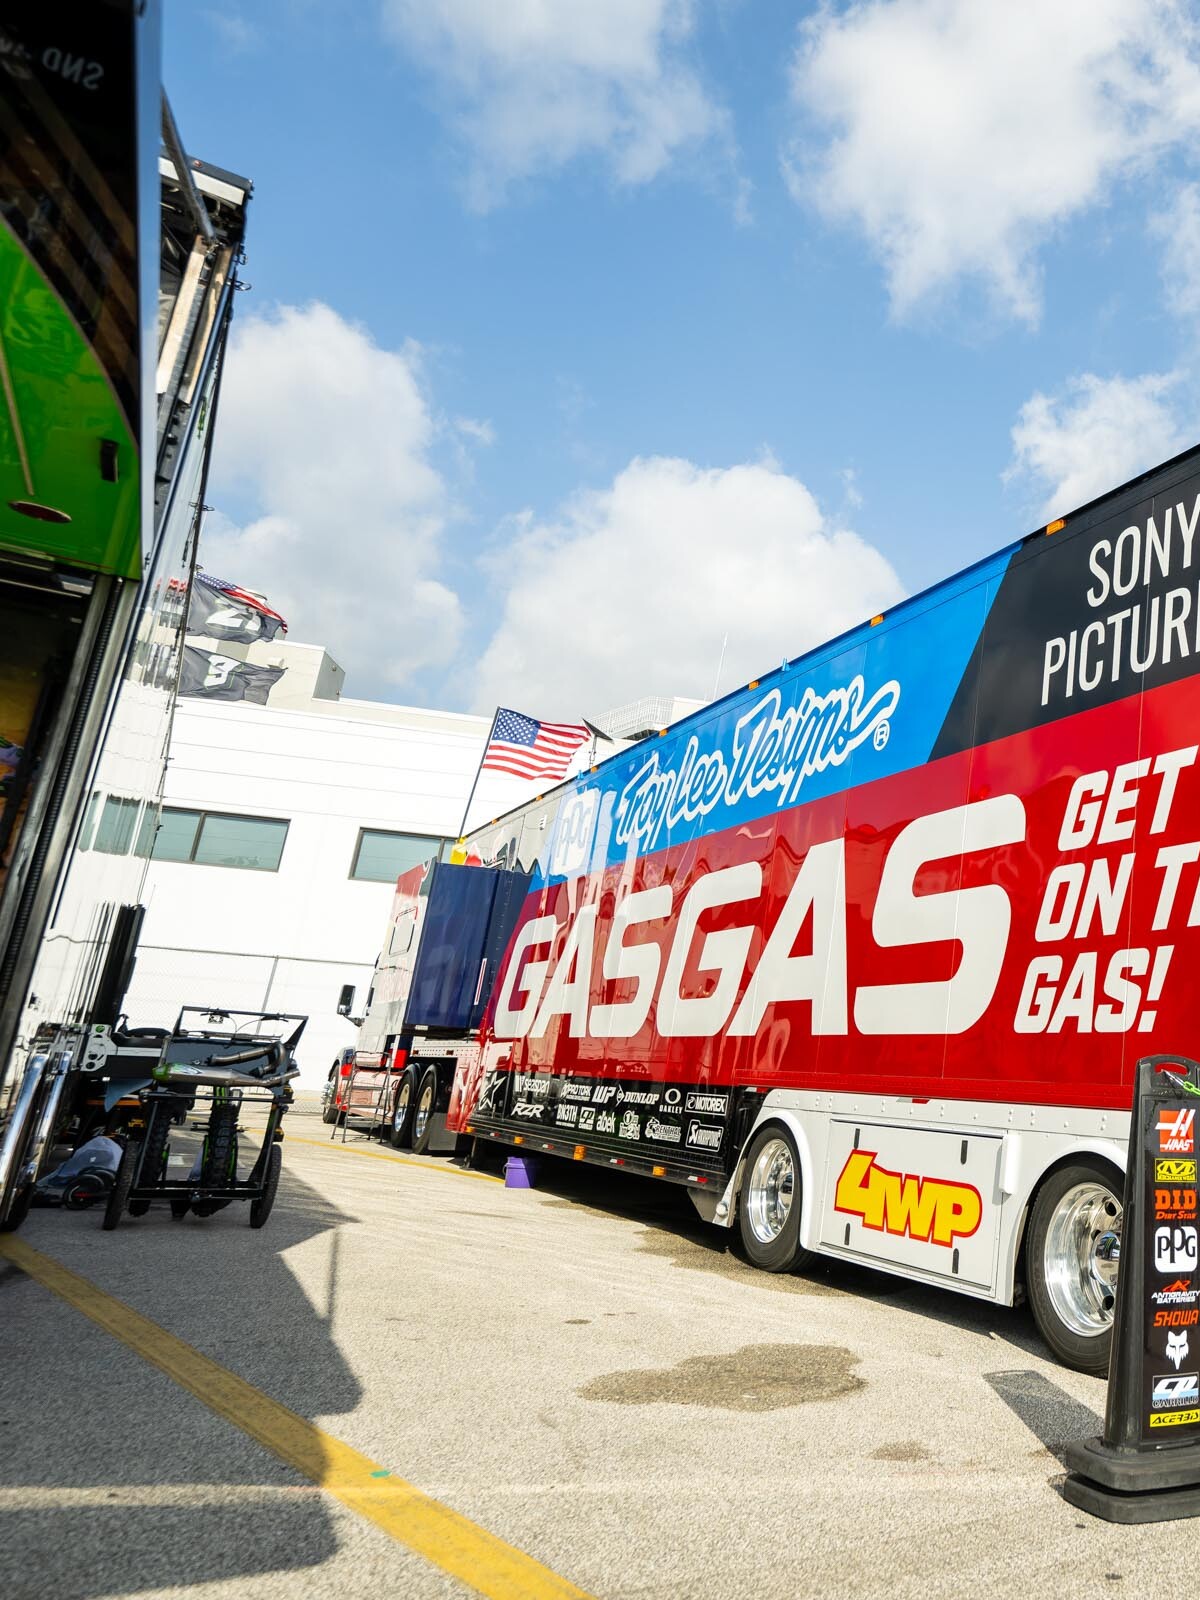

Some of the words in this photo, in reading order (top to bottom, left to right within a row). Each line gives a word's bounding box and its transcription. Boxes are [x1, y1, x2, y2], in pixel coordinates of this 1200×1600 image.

[615, 752, 678, 851] Troy
[667, 735, 727, 826] Lee
[725, 674, 900, 806] Designs
[1057, 745, 1199, 851] GET
[1034, 853, 1136, 942] ON
[494, 794, 1027, 1038] GASGAS
[1013, 945, 1174, 1033] GAS!
[592, 1086, 617, 1104] WP
[624, 1091, 660, 1105] DUNLOP
[695, 1096, 726, 1112] MOTOREX
[511, 1102, 545, 1118] RZR
[659, 1104, 683, 1115] OAKLEY
[1160, 1138, 1193, 1152] HAAS
[834, 1149, 983, 1248] 4WP
[1158, 1228, 1196, 1263] PPG
[1151, 1290, 1200, 1299] ANTIGRAVITY
[1153, 1309, 1200, 1327] SHOWA
